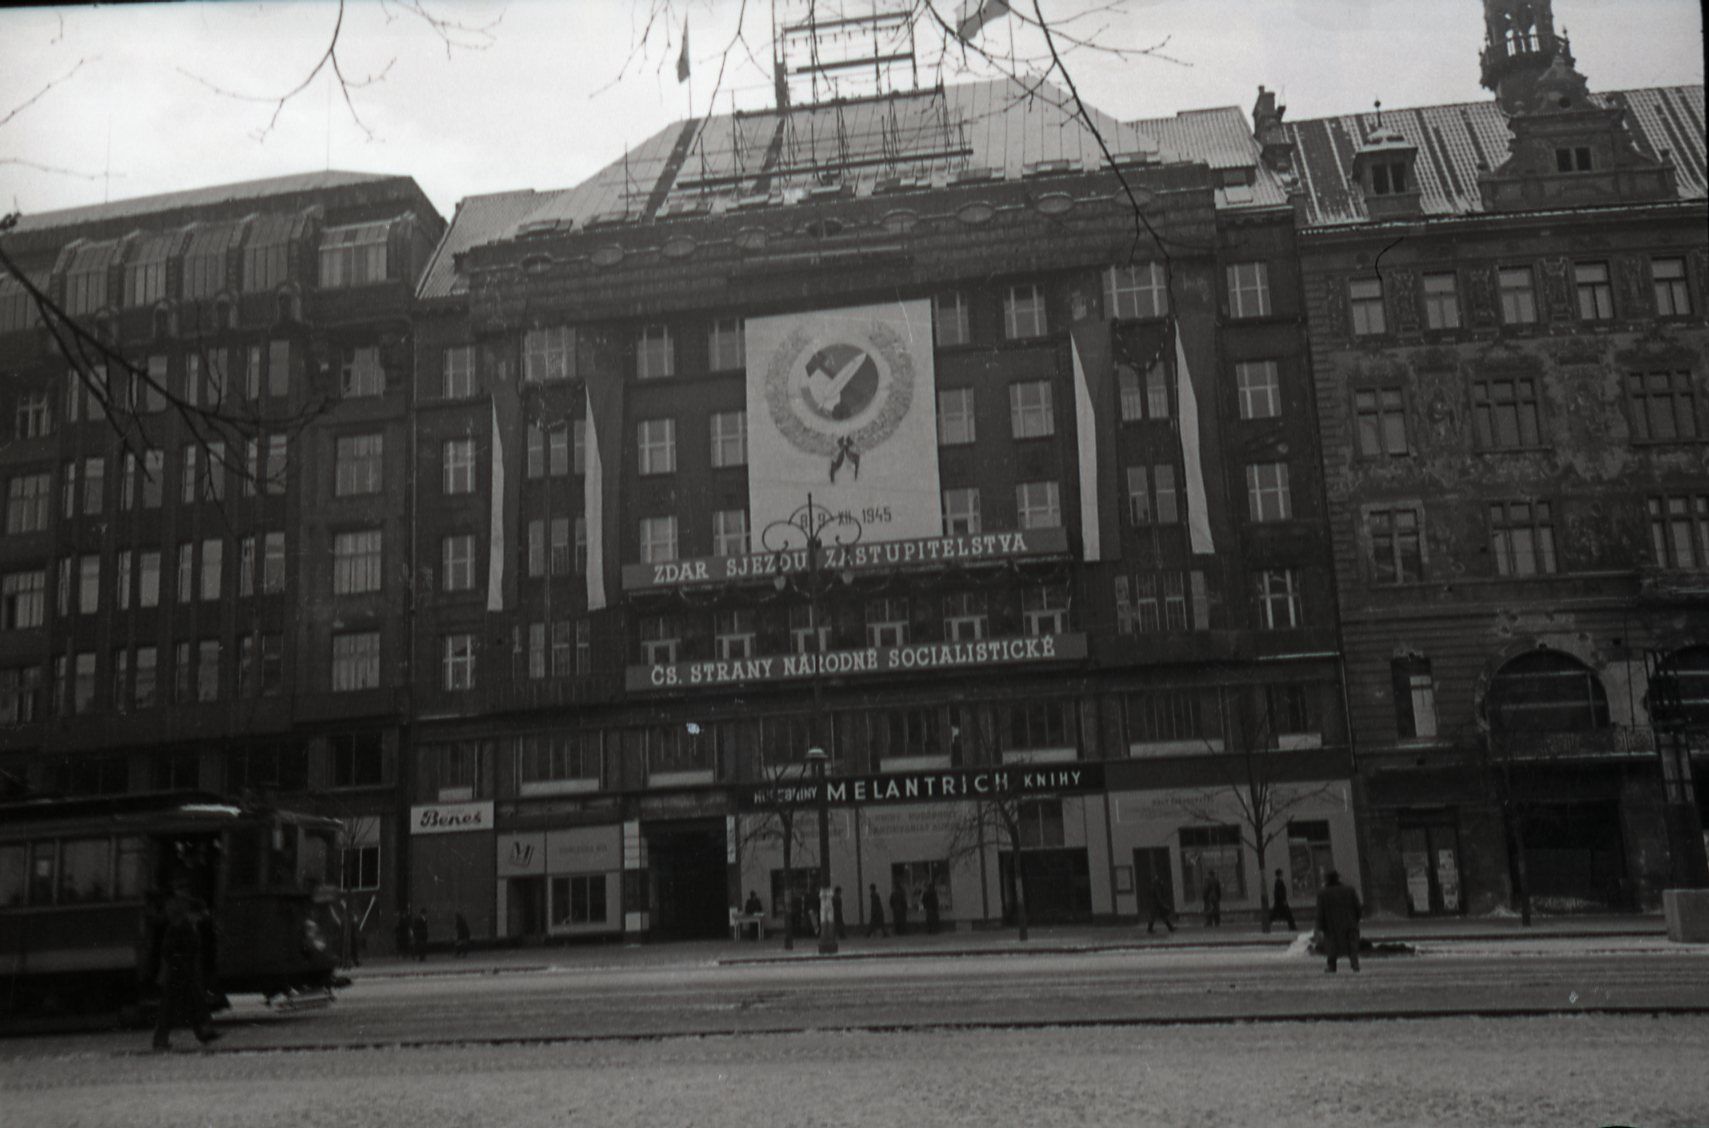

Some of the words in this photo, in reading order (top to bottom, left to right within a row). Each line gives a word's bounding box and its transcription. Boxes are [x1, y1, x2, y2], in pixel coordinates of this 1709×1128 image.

[862, 506, 892, 523] 1945
[652, 560, 710, 585] ZDAR
[650, 664, 683, 686] ČS.
[690, 658, 774, 684] STRANY
[888, 634, 1056, 668] SOCIALISTICKÉ
[826, 772, 1008, 802] MELANTRICH
[1023, 770, 1083, 788] KNIHY
